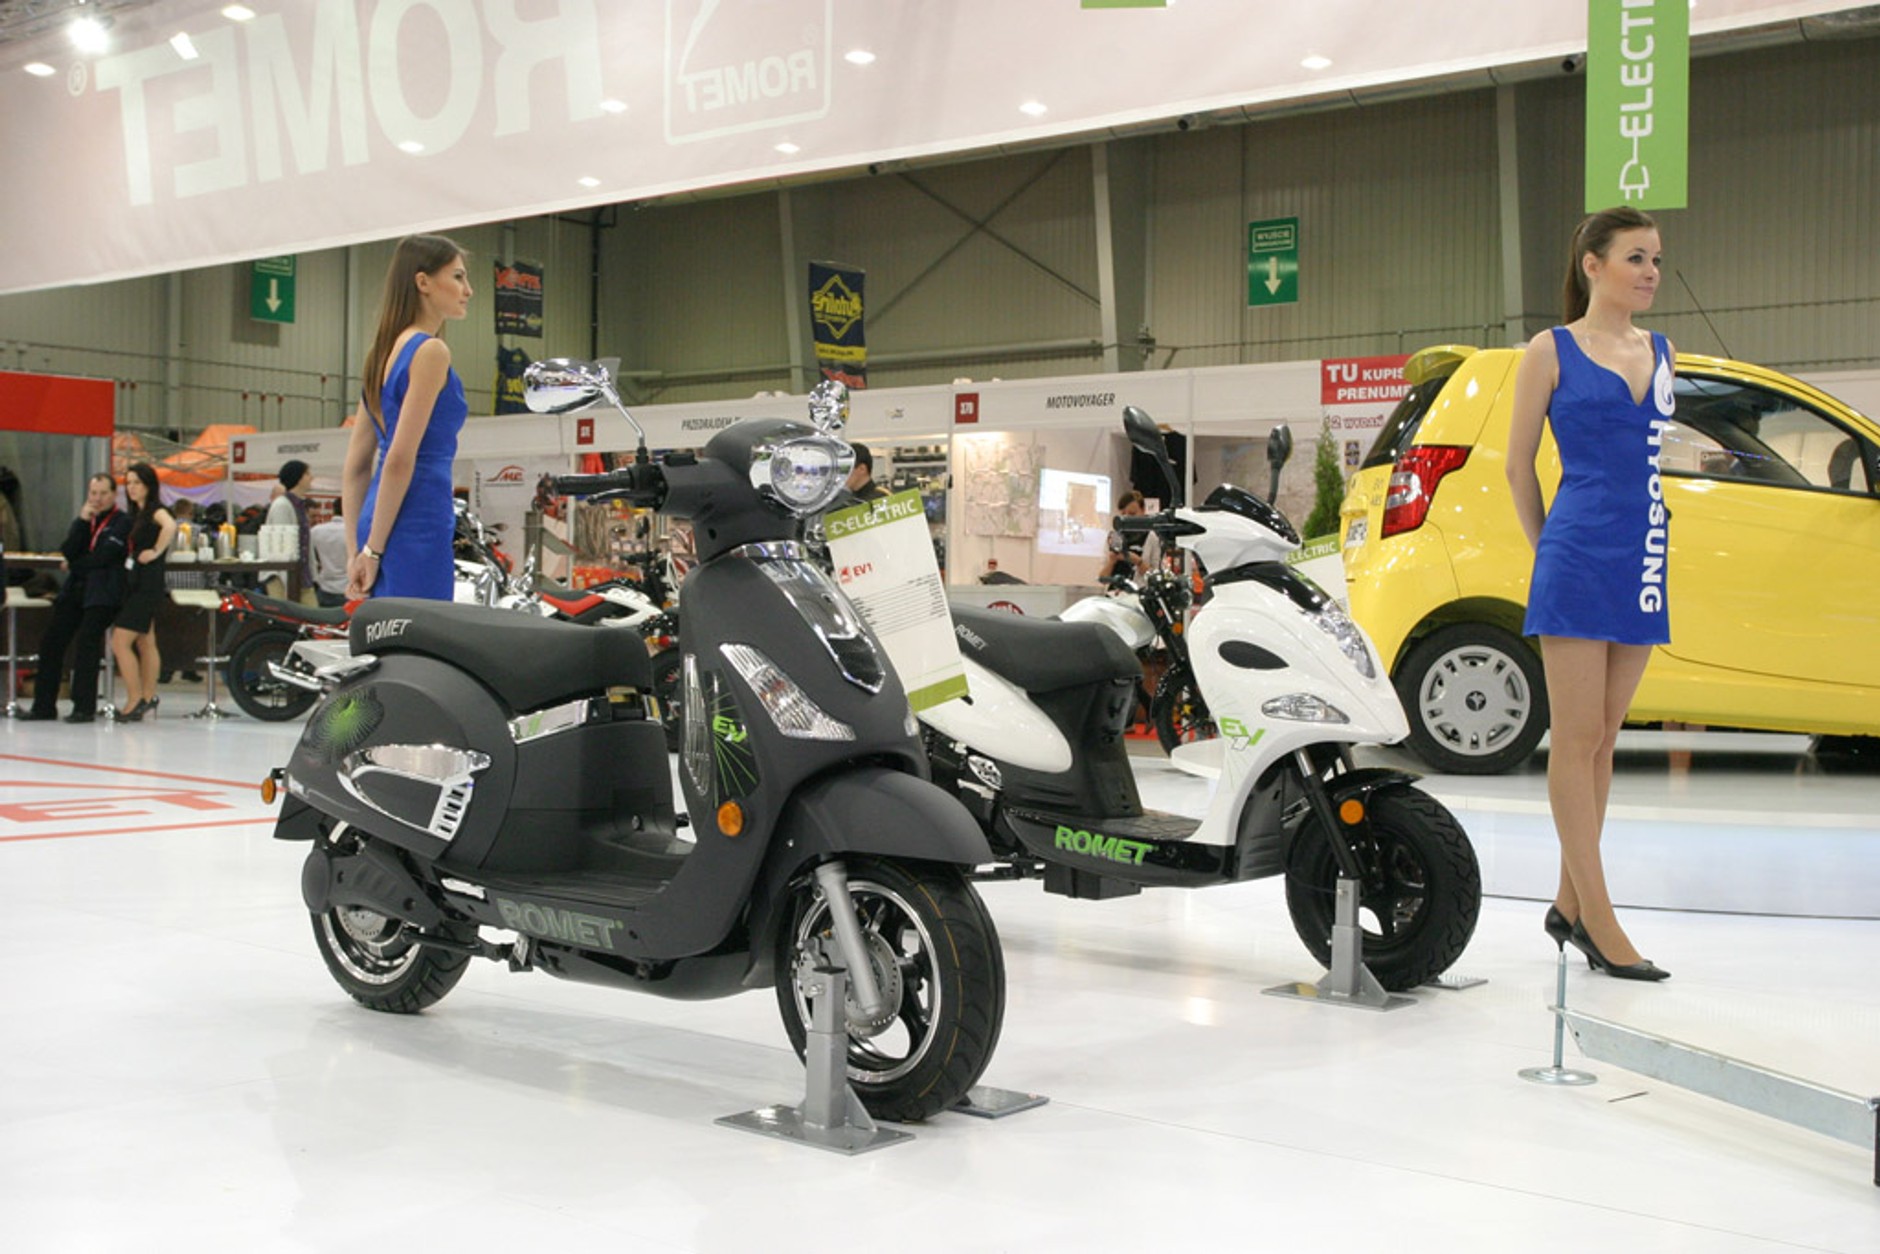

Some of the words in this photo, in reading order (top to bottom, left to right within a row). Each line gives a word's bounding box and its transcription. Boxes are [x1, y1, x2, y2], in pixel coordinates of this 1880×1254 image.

[1327, 364, 1358, 382] TU
[1362, 367, 1404, 380] KUPIS
[1046, 392, 1116, 409] MOTOVOYAGER
[846, 498, 918, 531] ELECTRIC
[1639, 419, 1665, 613] HYOSUNG
[853, 562, 873, 577] EV1
[366, 618, 413, 644] ROMET
[955, 624, 987, 650] ROMET
[1055, 824, 1153, 866] ROMET
[496, 898, 616, 949] ROMET
